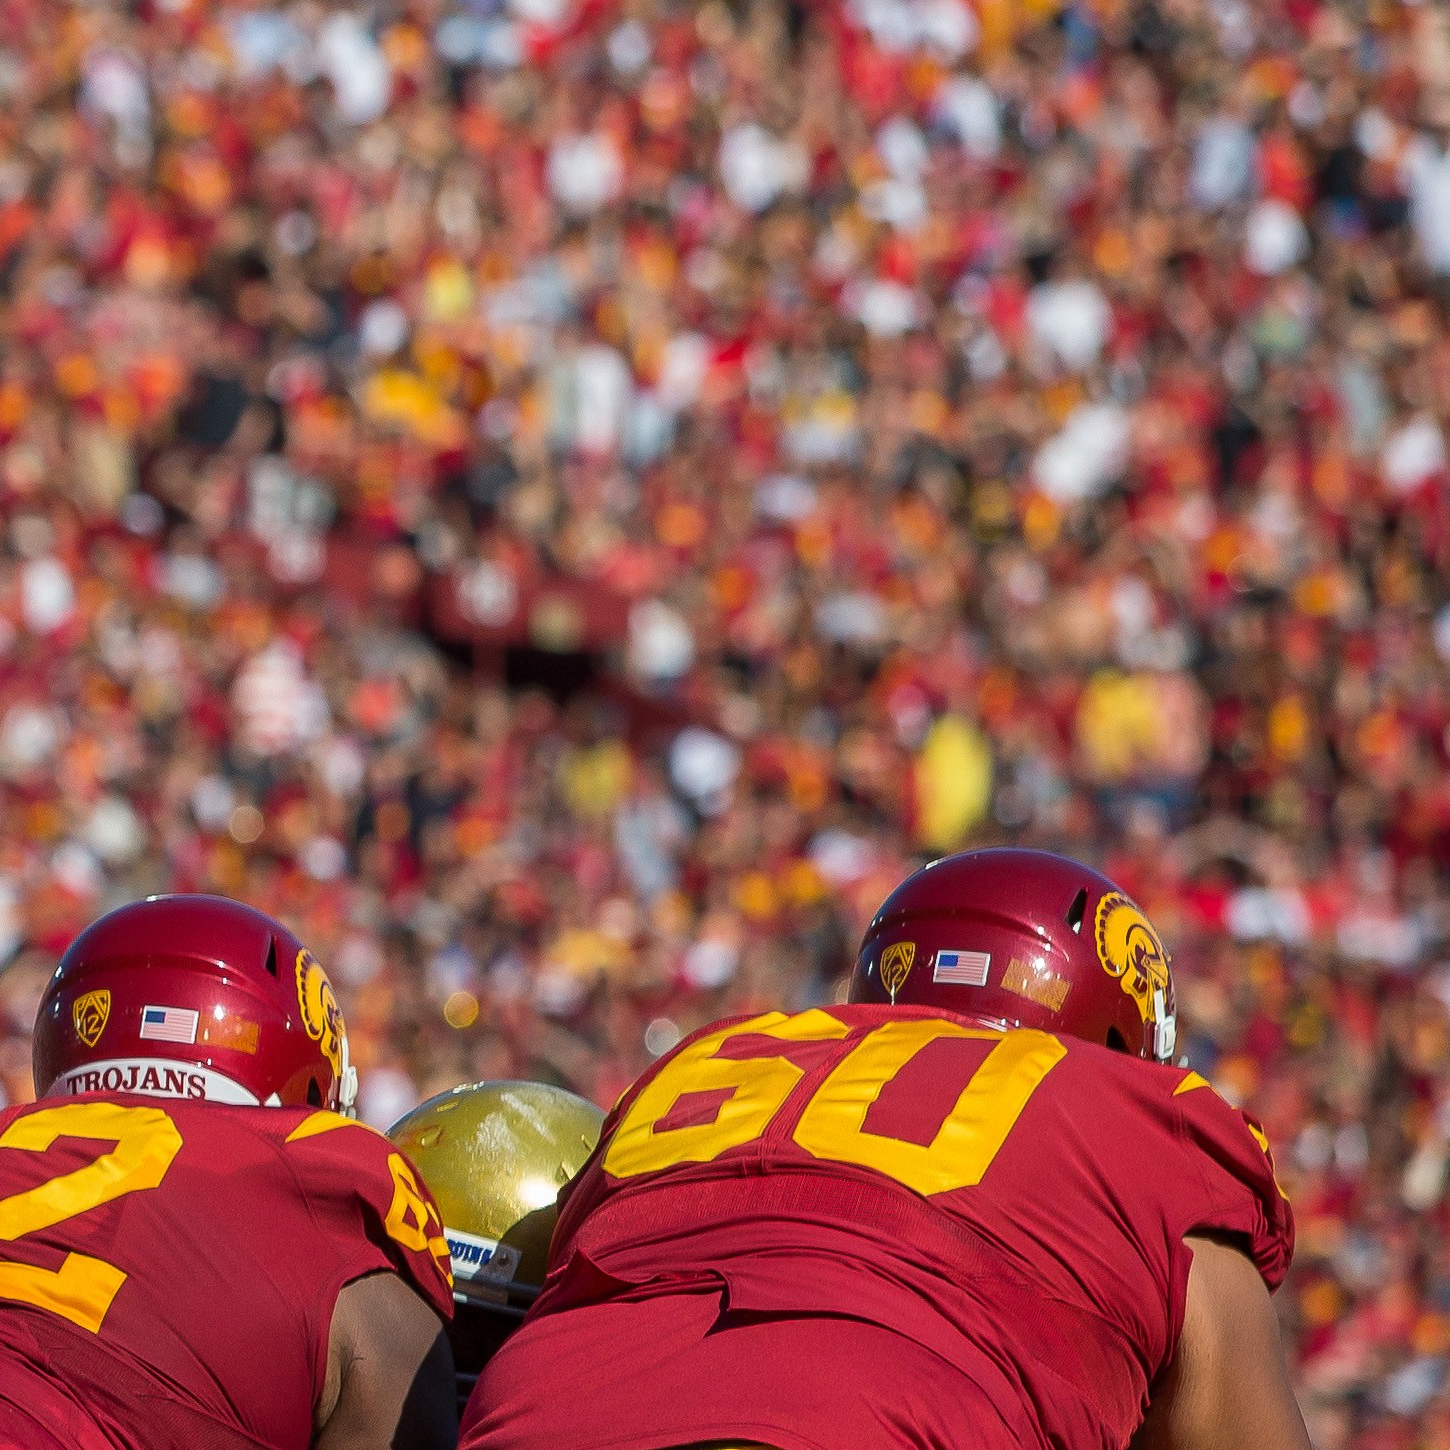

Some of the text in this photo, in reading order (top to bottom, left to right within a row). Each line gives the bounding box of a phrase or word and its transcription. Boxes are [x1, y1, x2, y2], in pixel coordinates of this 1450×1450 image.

[82, 1015, 100, 1036] 12
[66, 1066, 207, 1101] TROJANS
[603, 1006, 1068, 1197] 60
